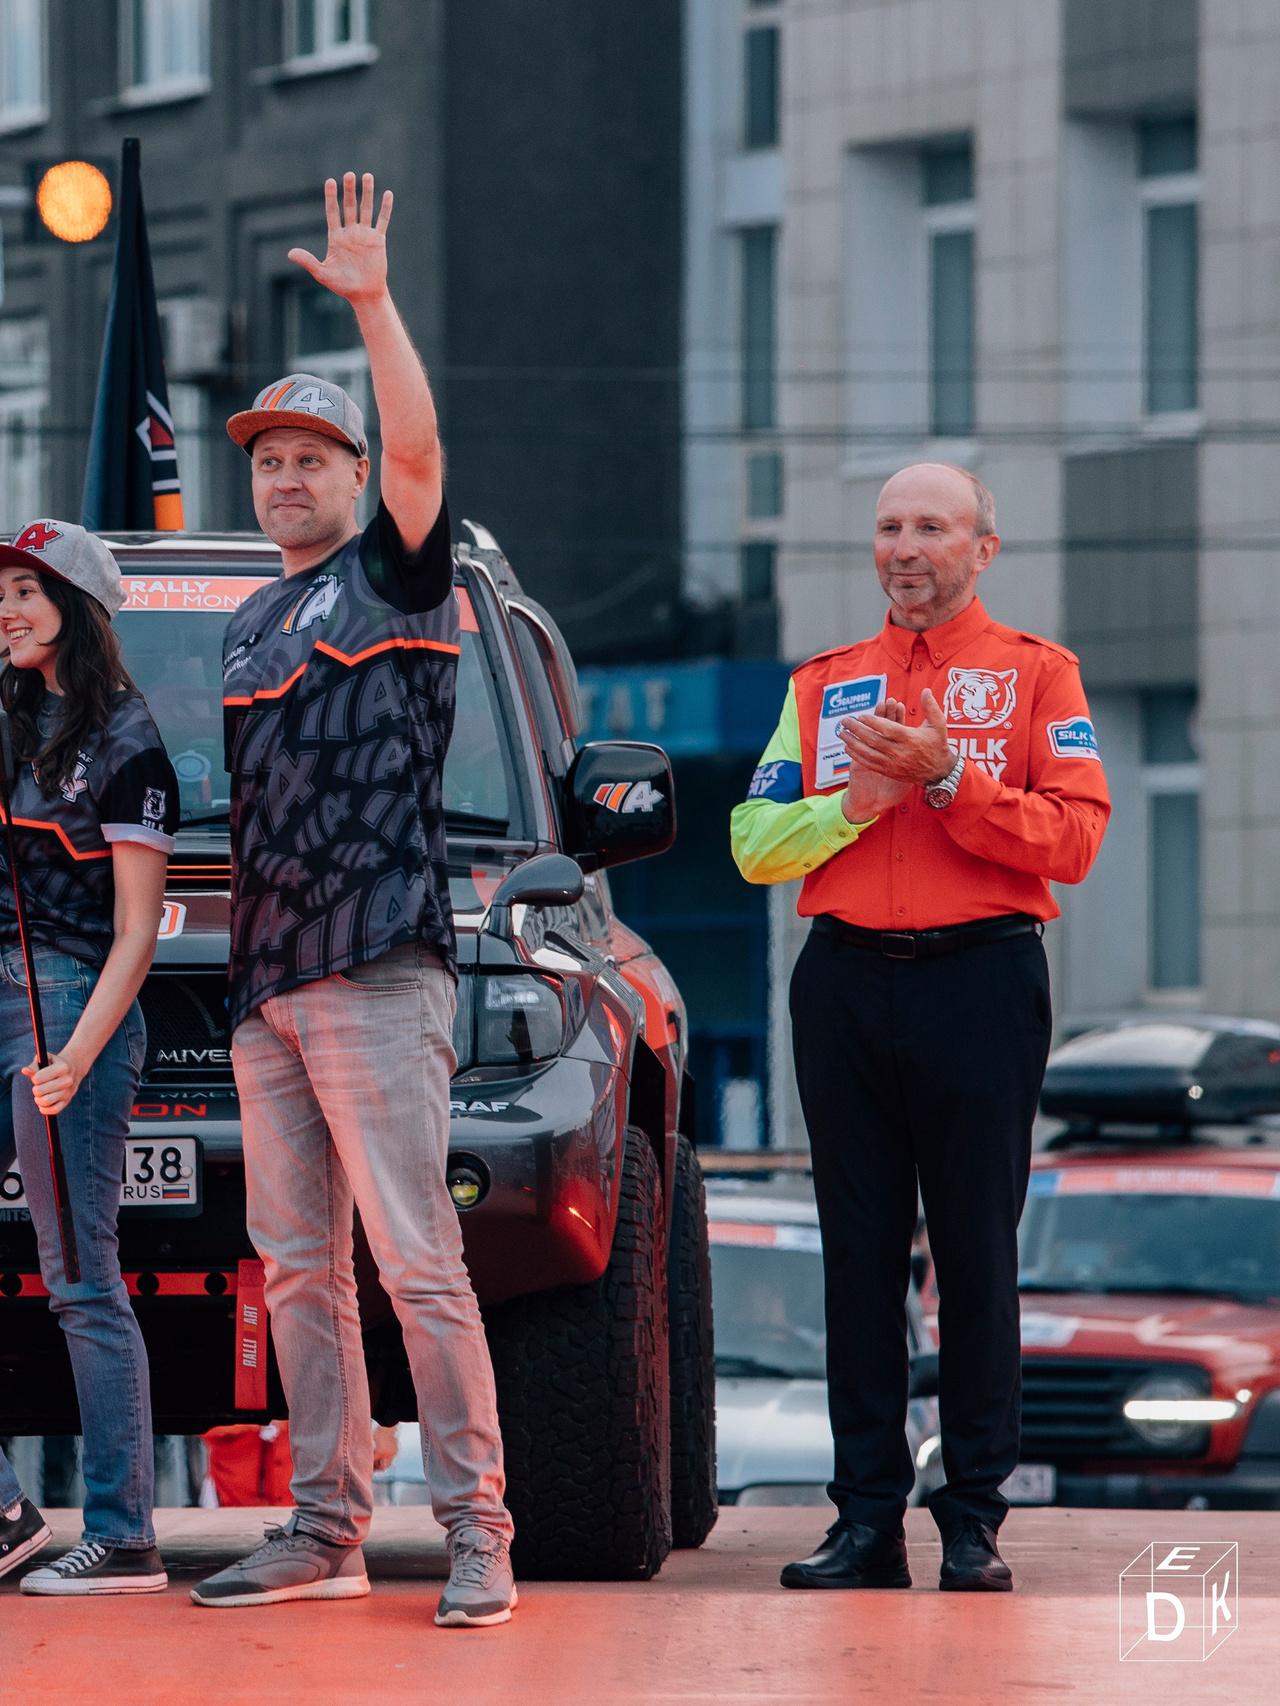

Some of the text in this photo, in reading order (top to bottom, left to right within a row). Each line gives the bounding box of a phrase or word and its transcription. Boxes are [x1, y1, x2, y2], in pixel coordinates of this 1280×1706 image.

[130, 580, 211, 593] RALLY
[183, 594, 251, 608] MON
[1058, 730, 1089, 741] SILK
[157, 1049, 234, 1063] MIVE
[123, 1185, 160, 1199] RUS
[243, 1304, 258, 1368] RALLI ART
